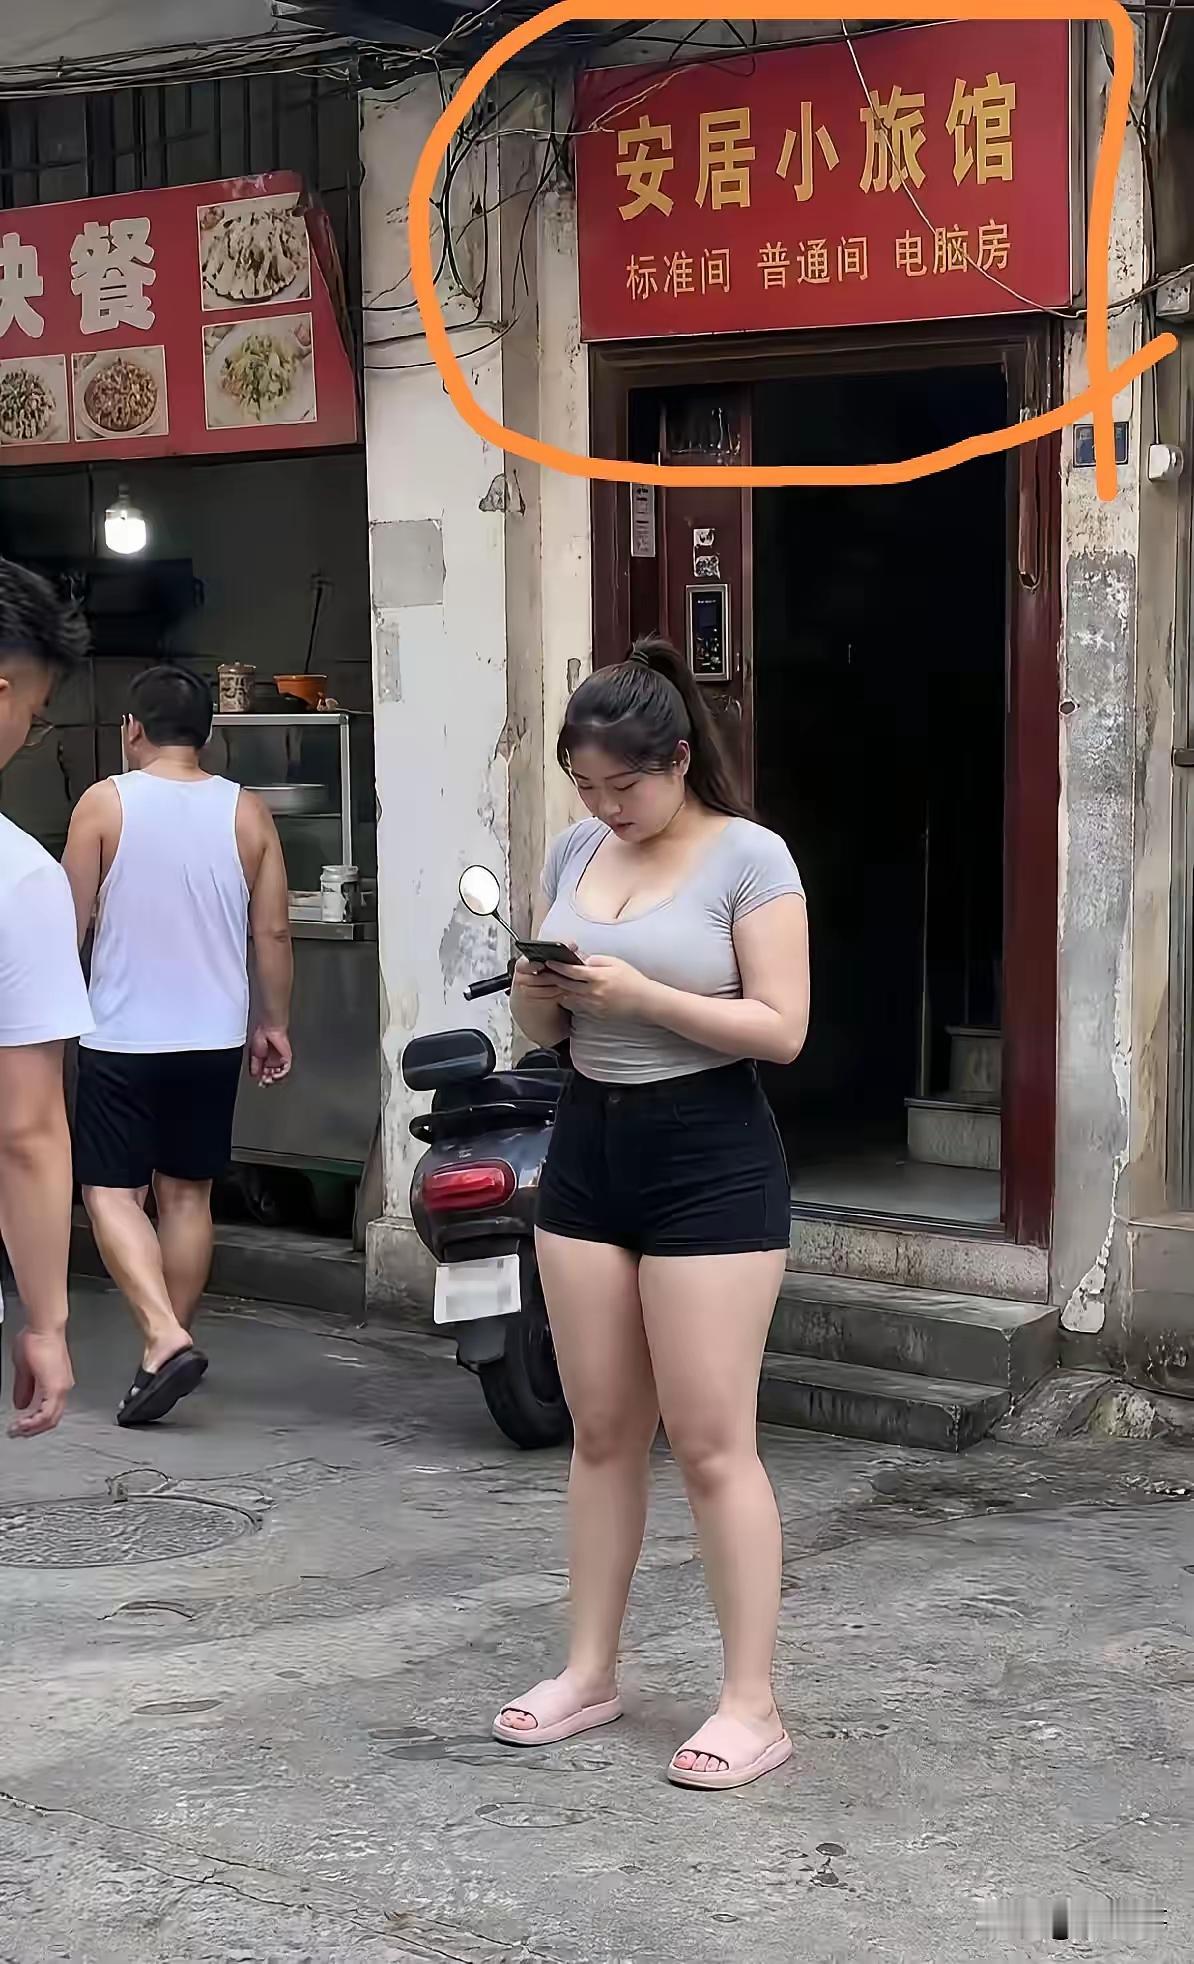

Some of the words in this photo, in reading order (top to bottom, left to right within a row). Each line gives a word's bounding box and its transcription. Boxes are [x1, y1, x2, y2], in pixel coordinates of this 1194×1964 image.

[616, 72, 1016, 221] 安居小旅馆
[626, 248, 730, 300] 标准间
[757, 236, 868, 290] 普通间
[895, 219, 1011, 277] 电脑房
